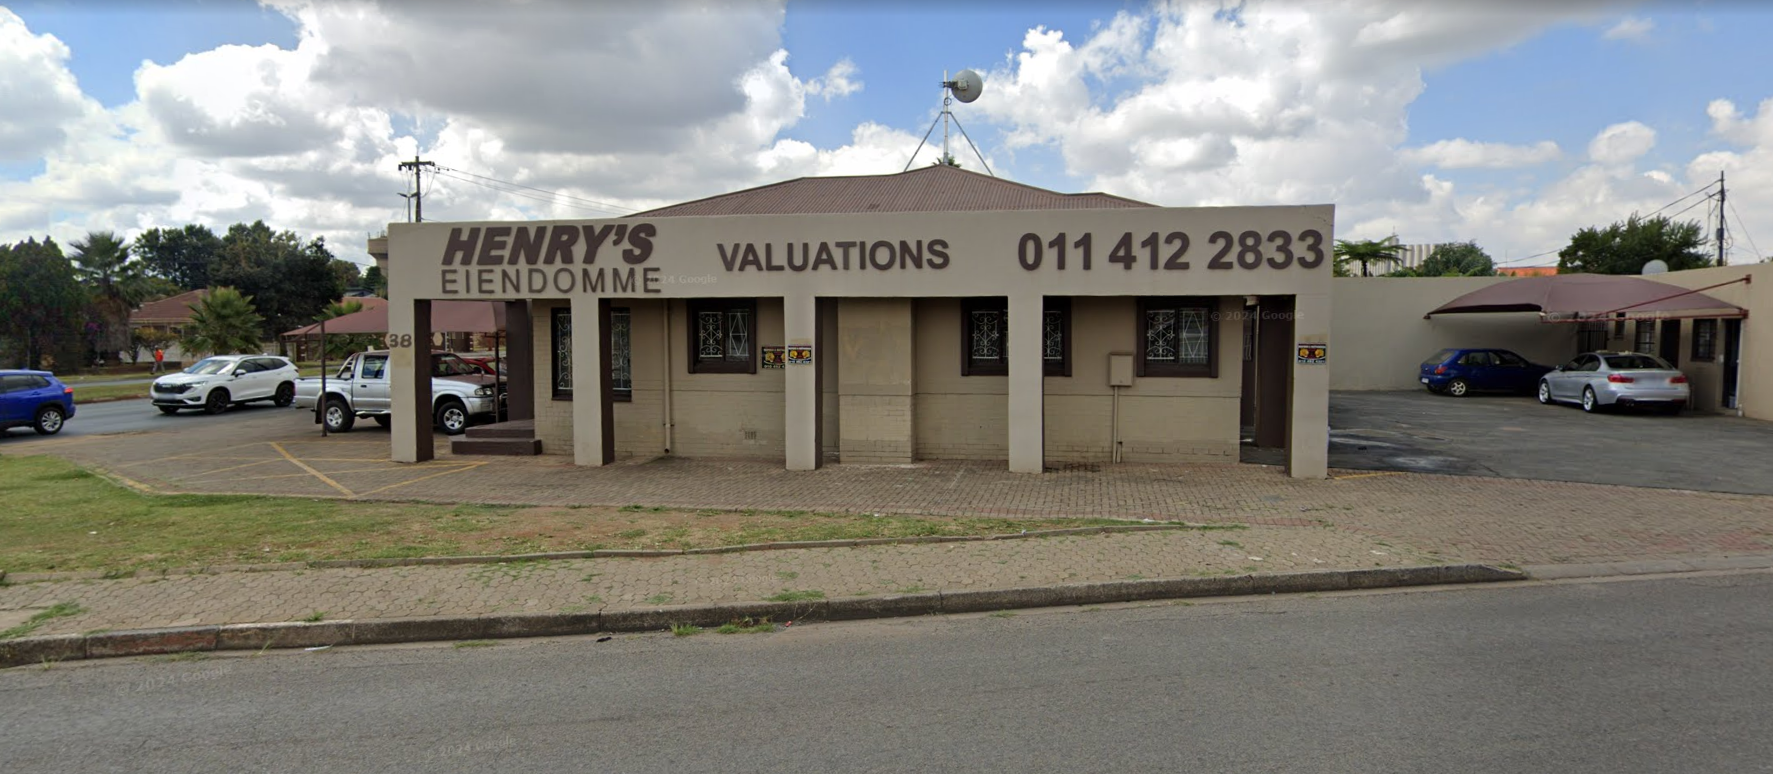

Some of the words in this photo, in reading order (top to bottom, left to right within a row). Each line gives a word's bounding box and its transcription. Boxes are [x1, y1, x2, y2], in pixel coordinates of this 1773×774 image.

[441, 222, 658, 267] HENRY'S
[717, 238, 951, 273] VALUATIONS
[1017, 231, 1093, 272] 011
[1108, 231, 1191, 272] 412
[1206, 228, 1325, 271] 2833
[441, 266, 662, 295] EIENDOMME
[388, 333, 413, 349] 38
